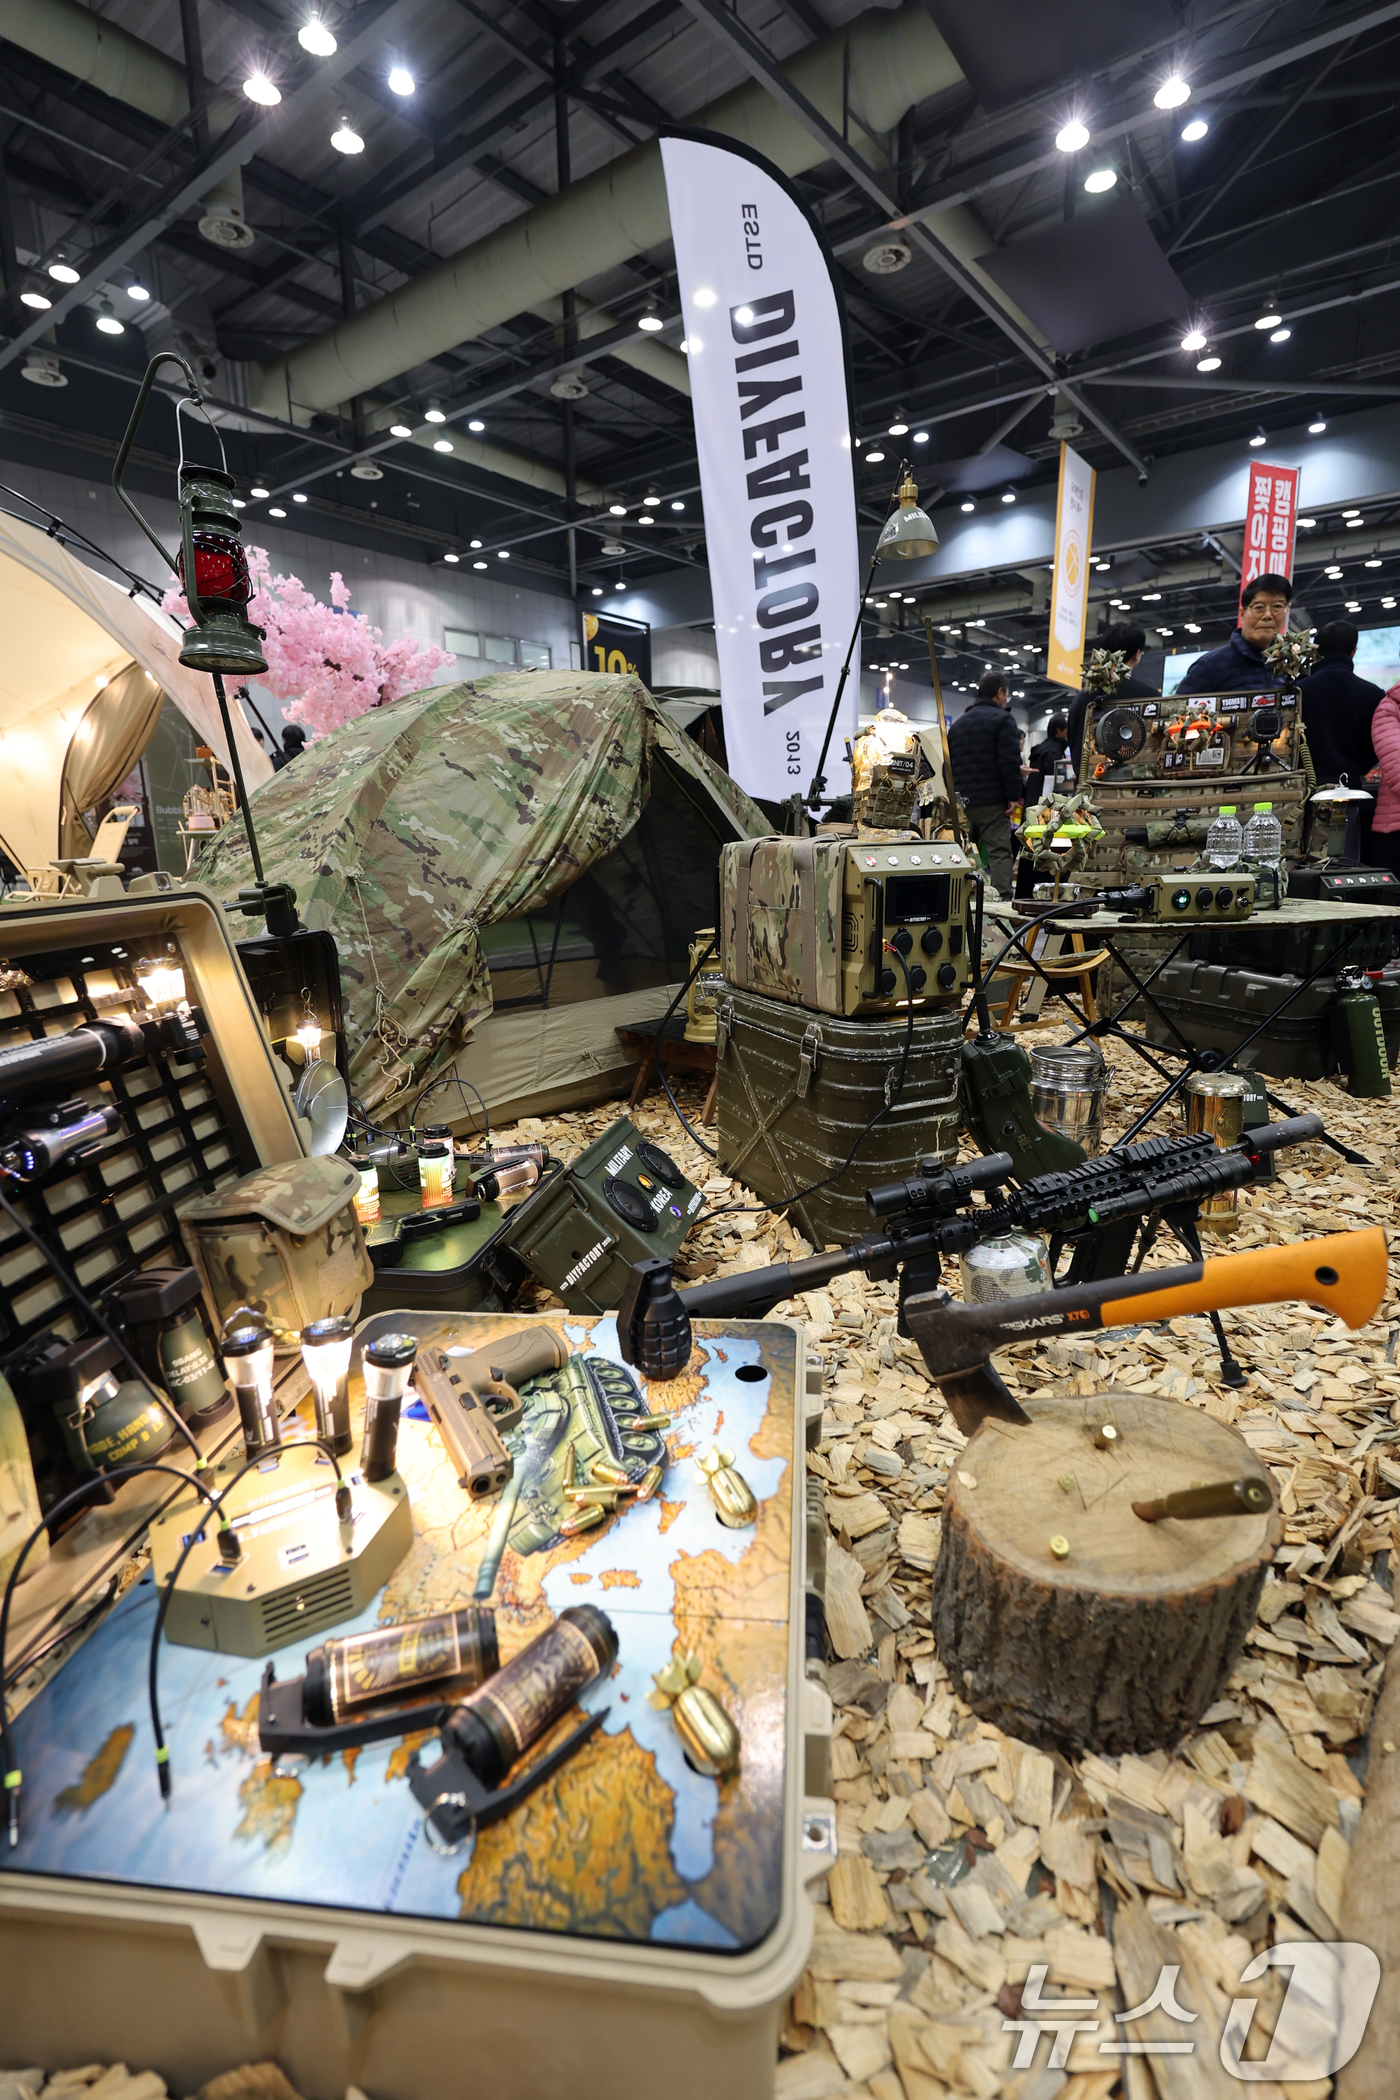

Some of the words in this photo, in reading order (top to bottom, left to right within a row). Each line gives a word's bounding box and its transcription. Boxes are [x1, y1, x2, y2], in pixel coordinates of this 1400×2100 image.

[1372, 1006, 1391, 1079] OUTDOOR
[604, 1144, 635, 1178] MILITARY
[650, 1186, 674, 1214] KOREA
[565, 1242, 605, 1286] DIYFACTORY
[171, 1347, 203, 1369] 9BANG
